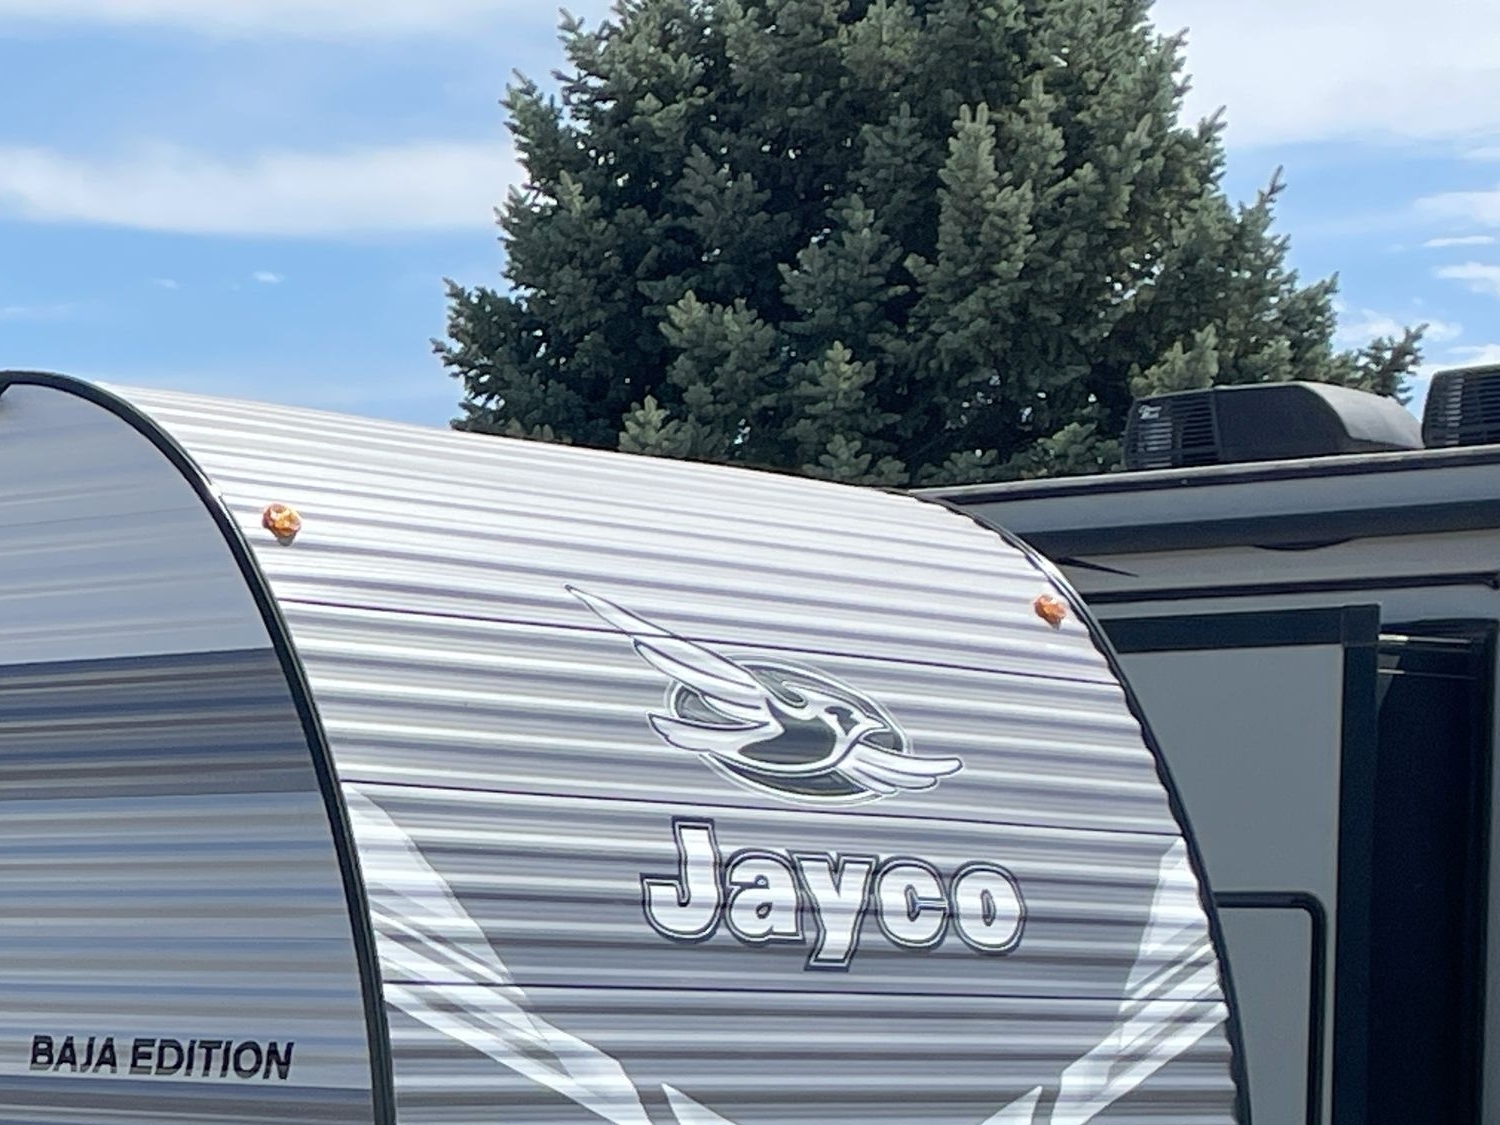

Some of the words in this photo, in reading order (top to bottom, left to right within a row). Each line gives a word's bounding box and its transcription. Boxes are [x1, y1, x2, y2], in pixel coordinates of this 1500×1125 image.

[640, 816, 1027, 971] Jayco
[29, 1034, 118, 1074] BAJA
[128, 1037, 295, 1080] EDITION
